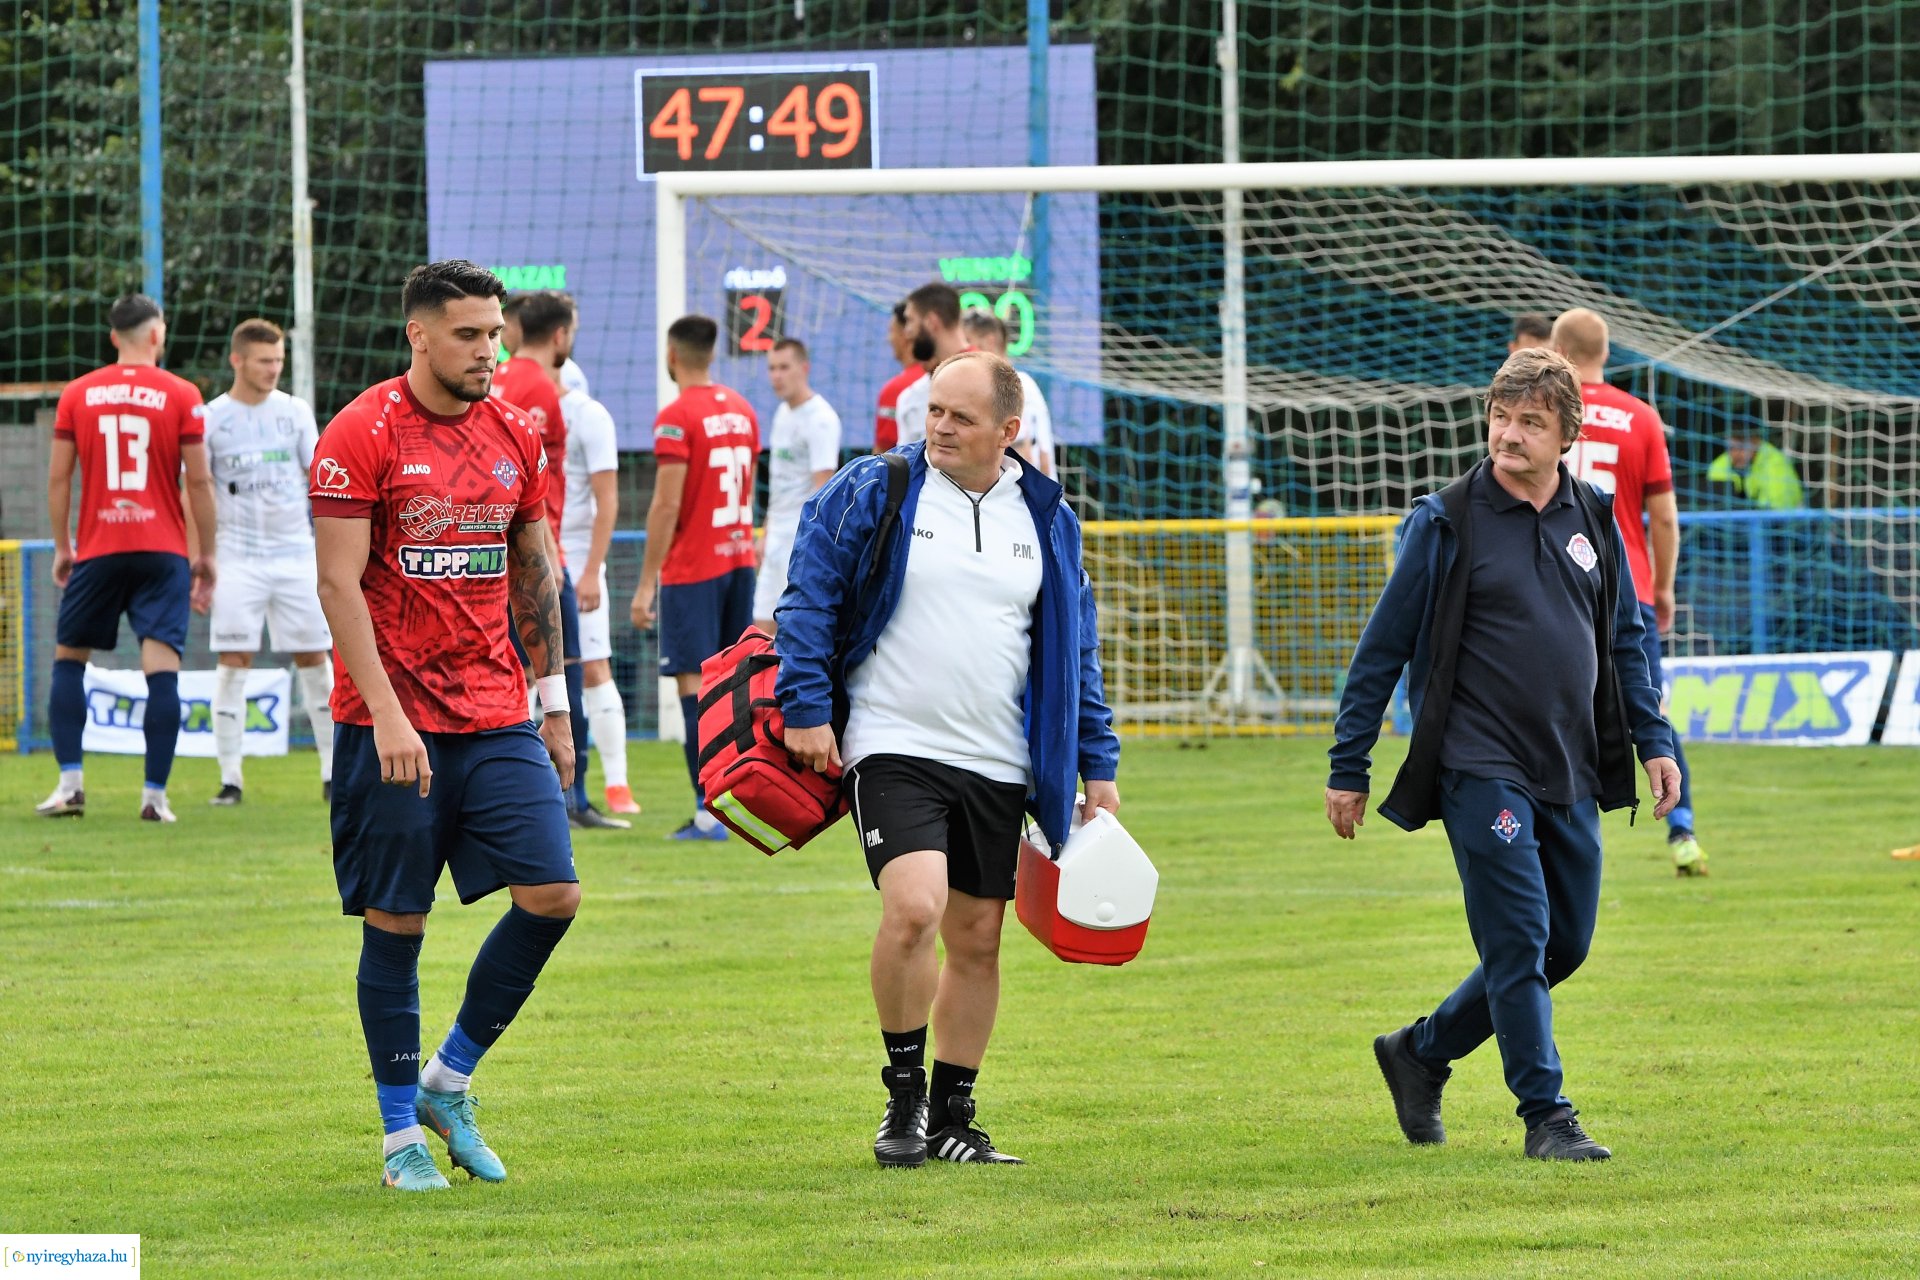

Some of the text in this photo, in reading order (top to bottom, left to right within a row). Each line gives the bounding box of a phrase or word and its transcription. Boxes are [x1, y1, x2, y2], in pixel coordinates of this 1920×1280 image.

[649, 82, 863, 161] 47:49
[739, 295, 775, 352] 2
[959, 291, 1035, 357] 0
[98, 414, 150, 492] 13
[402, 464, 431, 475] JAKO
[709, 445, 753, 528] 30
[911, 527, 934, 540] AKO
[1012, 542, 1034, 560] P.M.
[865, 828, 884, 848] P.M.
[490, 1022, 507, 1031] JA
[889, 1044, 919, 1053] JAKO
